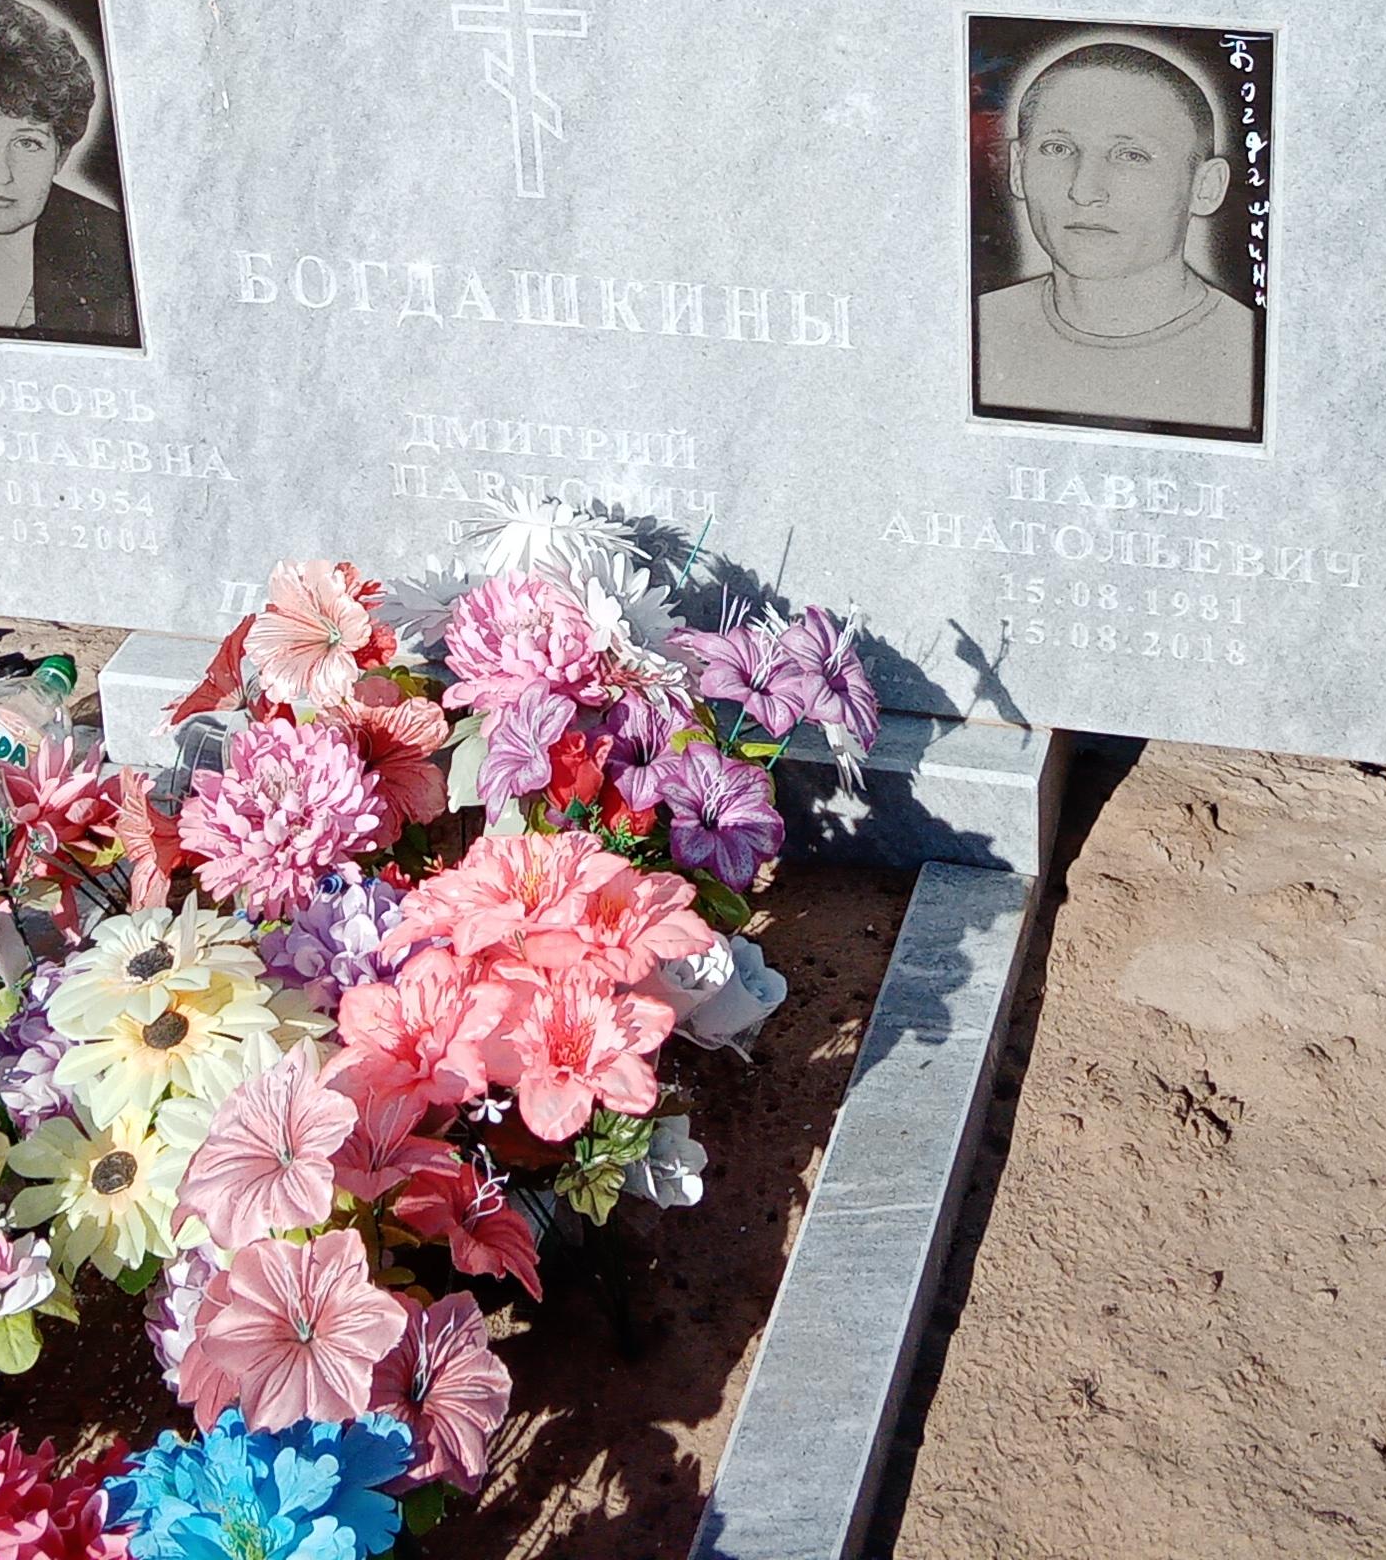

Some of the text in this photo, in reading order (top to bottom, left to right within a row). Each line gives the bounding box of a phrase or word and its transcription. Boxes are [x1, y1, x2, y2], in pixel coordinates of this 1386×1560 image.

[236, 250, 857, 349] БОГДАШКИНЫ
[404, 412, 697, 469] ДМИТРИЙ
[1007, 464, 1230, 521] ПАВЕЛ
[878, 510, 1365, 588] АНАТОЛЬЕВИЧ
[998, 574, 1246, 625] 15.08.1981
[1000, 615, 1247, 666] 15.08.2018
